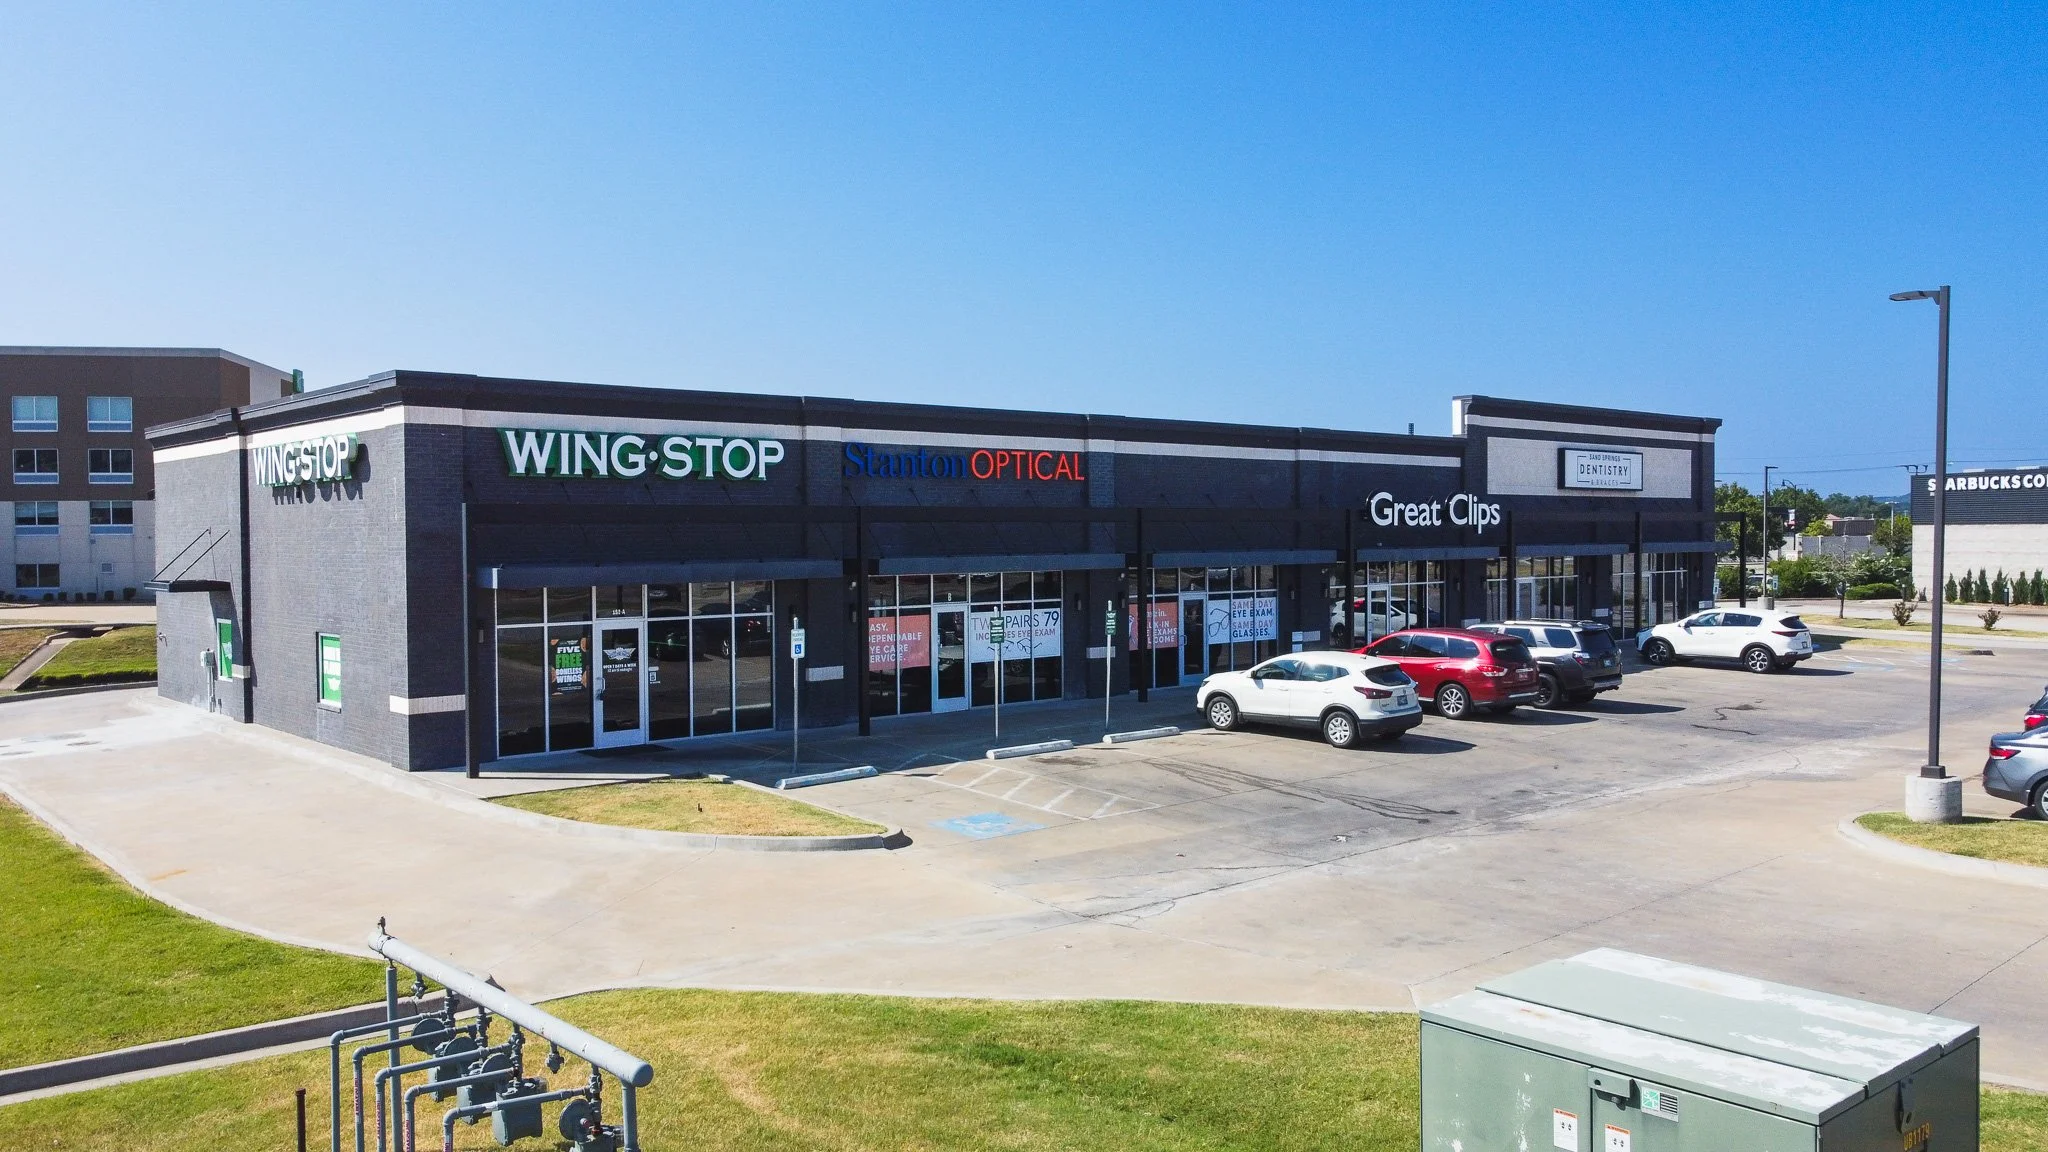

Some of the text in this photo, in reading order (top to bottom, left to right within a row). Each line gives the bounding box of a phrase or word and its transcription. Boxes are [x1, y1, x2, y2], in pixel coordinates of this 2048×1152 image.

[842, 442, 1085, 480] Stanton OPTICAL
[1580, 464, 1628, 476] DENTISTRY
[1928, 474, 2048, 492] SARBUCKS CO
[1371, 492, 1500, 534] Great Clips
[1232, 600, 1273, 609] SAME DAY
[1232, 610, 1246, 618] EYE
[971, 617, 990, 630] TW
[1006, 614, 1039, 628] PAIRS
[1232, 620, 1273, 629] SAME DAY
[869, 623, 888, 632] ASY.
[976, 629, 1055, 640] INCDES EYE EXAM
[1232, 628, 1270, 638] GLASSES.
[869, 644, 909, 654] YE CARE
[555, 653, 582, 668] FREE
[870, 653, 906, 663] ERVICE.
[556, 675, 582, 683] WINGS
